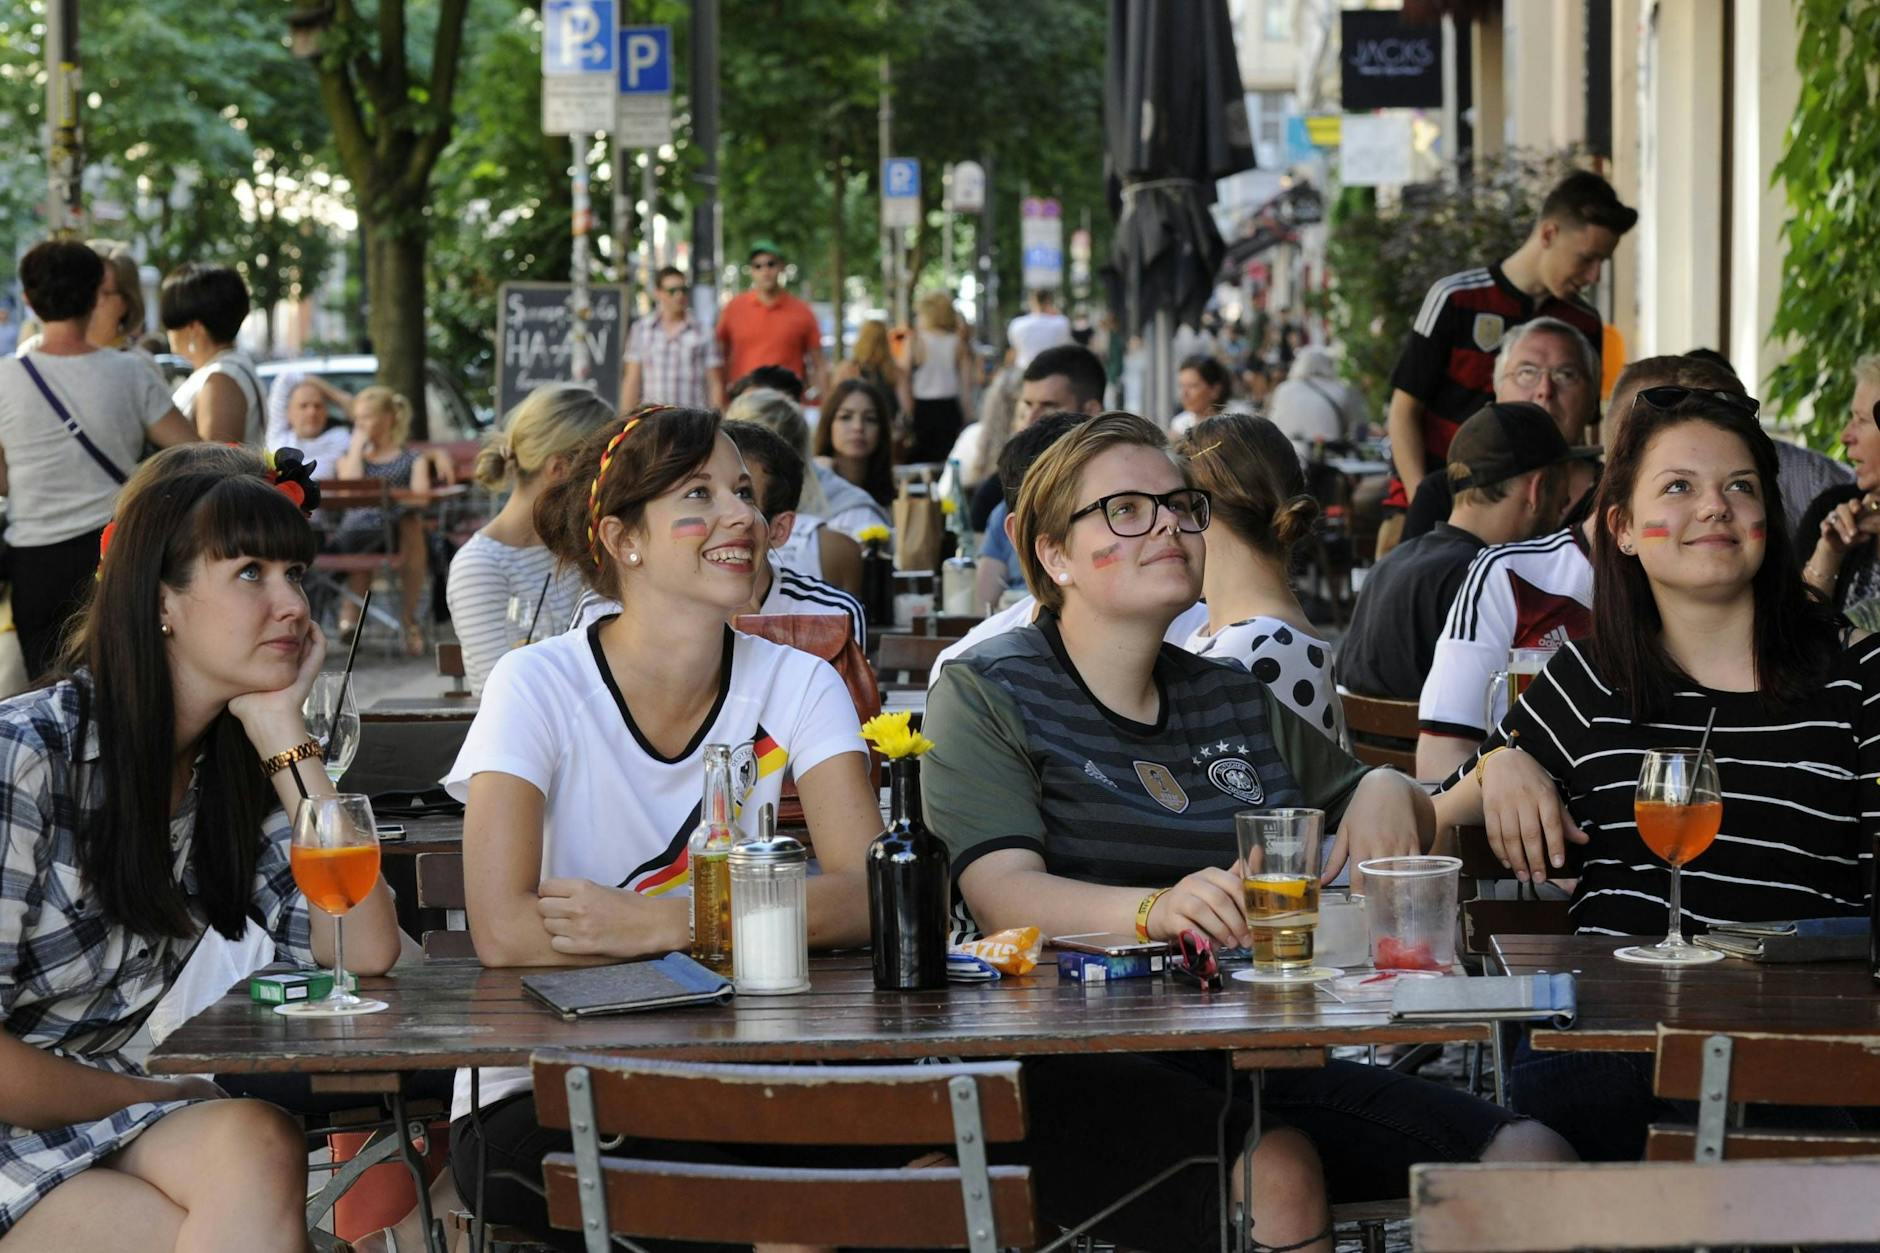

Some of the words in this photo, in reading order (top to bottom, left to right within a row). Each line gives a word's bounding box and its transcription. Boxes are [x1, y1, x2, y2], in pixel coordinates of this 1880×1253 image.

[560, 6, 600, 65] P
[626, 34, 660, 89] P
[1538, 637, 1563, 649] adid
